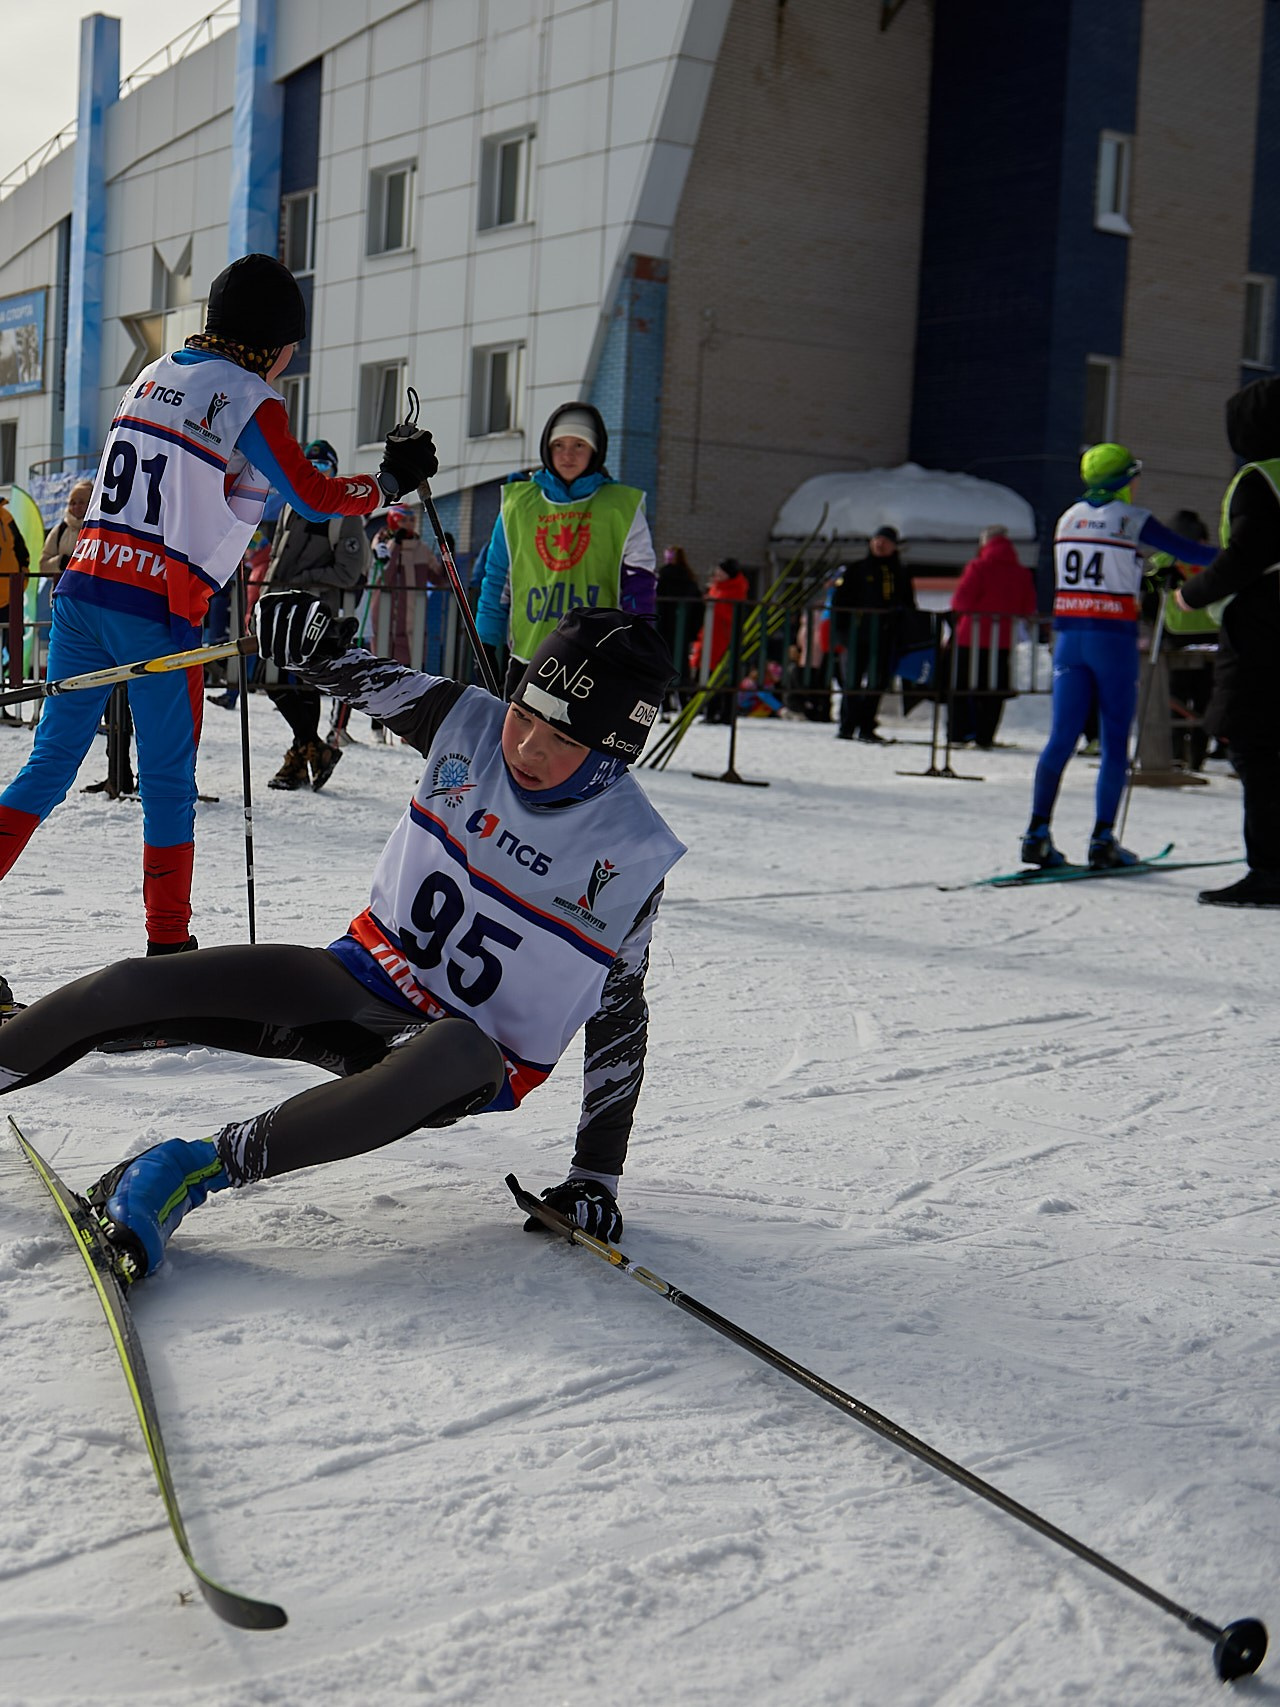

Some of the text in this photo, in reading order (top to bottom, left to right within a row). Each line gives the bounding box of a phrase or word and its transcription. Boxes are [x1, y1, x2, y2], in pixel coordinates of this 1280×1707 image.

[151, 385, 186, 407] ПСБ
[99, 440, 169, 526] 91
[72, 538, 168, 580] ДМУРТИ
[1064, 549, 1105, 587] 94
[538, 656, 595, 699] DNB
[634, 704, 656, 725] DNB
[496, 829, 553, 876] ПСБ
[398, 870, 524, 1008] 95
